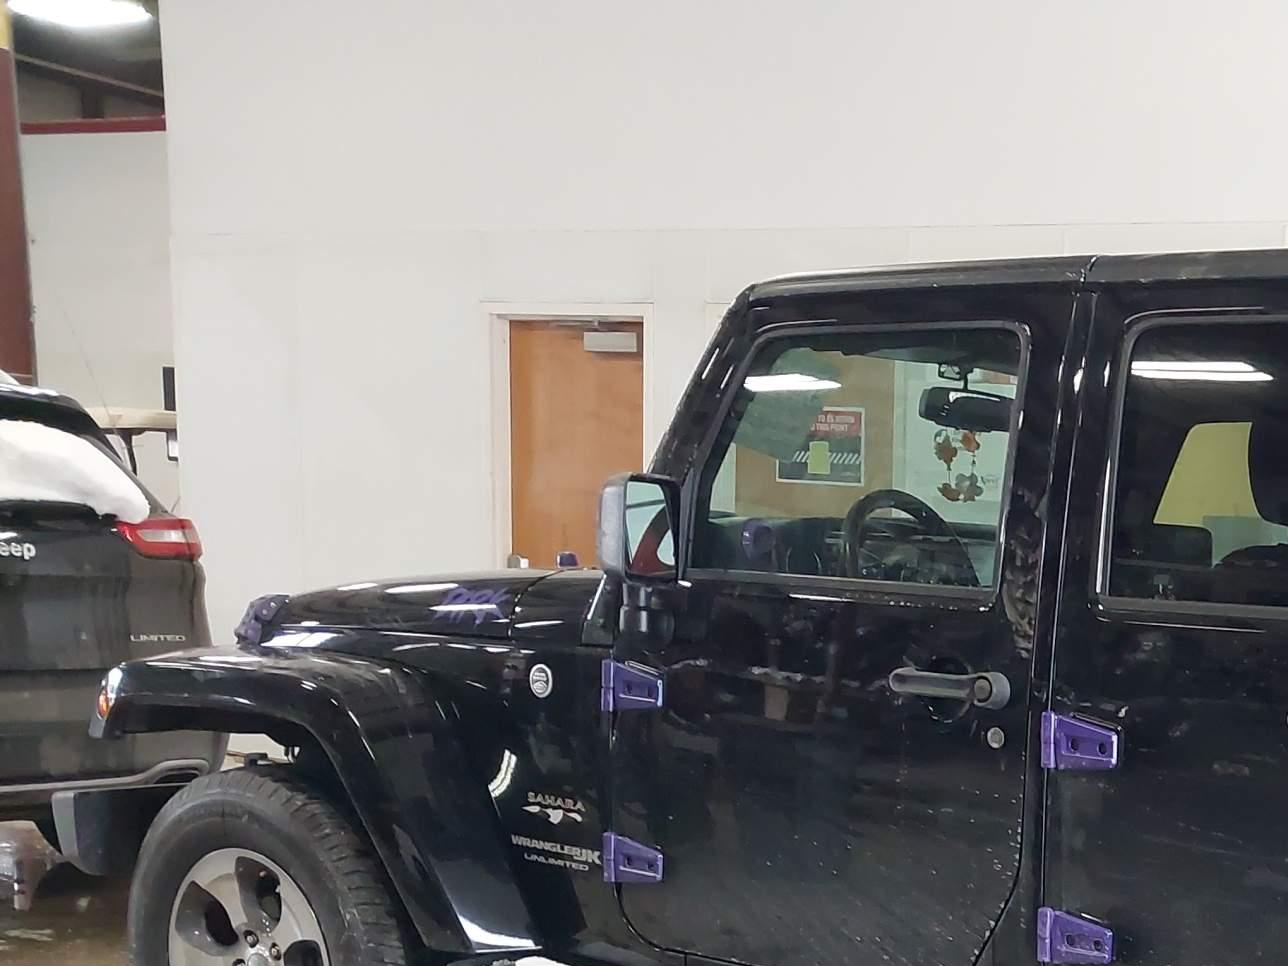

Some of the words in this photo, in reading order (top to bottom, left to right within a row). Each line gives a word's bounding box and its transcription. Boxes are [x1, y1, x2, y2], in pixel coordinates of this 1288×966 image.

[0, 542, 36, 560] eep
[130, 633, 186, 643] LIMITED
[527, 791, 587, 813] SAHARA
[523, 852, 590, 872] UNLIMITED
